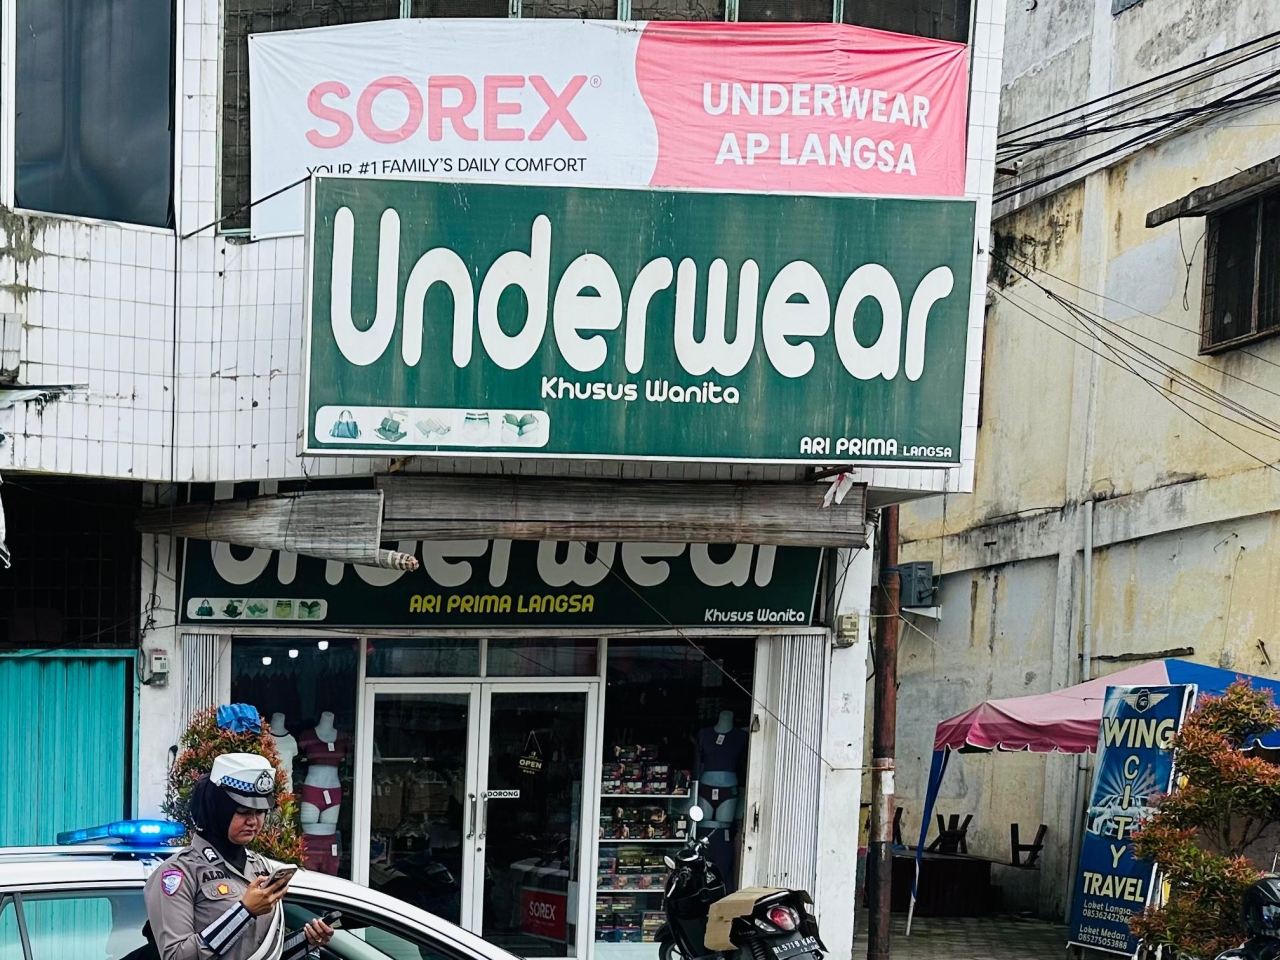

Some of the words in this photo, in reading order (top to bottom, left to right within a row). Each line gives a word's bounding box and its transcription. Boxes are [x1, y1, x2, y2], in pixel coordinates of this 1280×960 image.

[305, 75, 588, 149] SOREX
[703, 82, 930, 129] UNDERWEAR
[715, 132, 770, 165] AP
[780, 133, 918, 176] LANGSA
[358, 161, 376, 174] #1
[382, 158, 453, 173] FAMILY'S
[457, 157, 501, 172] DAILY
[504, 157, 588, 172] COMFORT
[331, 206, 954, 382] Underwear
[541, 376, 638, 401] Khusus
[645, 378, 740, 405] Wanita
[800, 437, 831, 455] ARI
[835, 438, 898, 456] PRIMA
[903, 445, 952, 458] LANGSA
[409, 594, 441, 613] ARI
[447, 594, 512, 613] PRIMA
[517, 594, 595, 613] LANGSA
[704, 608, 754, 622] Khusus
[757, 608, 805, 622] Wanita
[1103, 717, 1176, 750] WING
[519, 758, 542, 770] OPEN
[488, 790, 519, 798] DORONG
[1083, 872, 1144, 902] TRAVEL
[529, 900, 556, 921] SOREX
[1084, 900, 1104, 911] Loket
[1080, 924, 1099, 935] Loket
[1100, 928, 1125, 940] Medan
